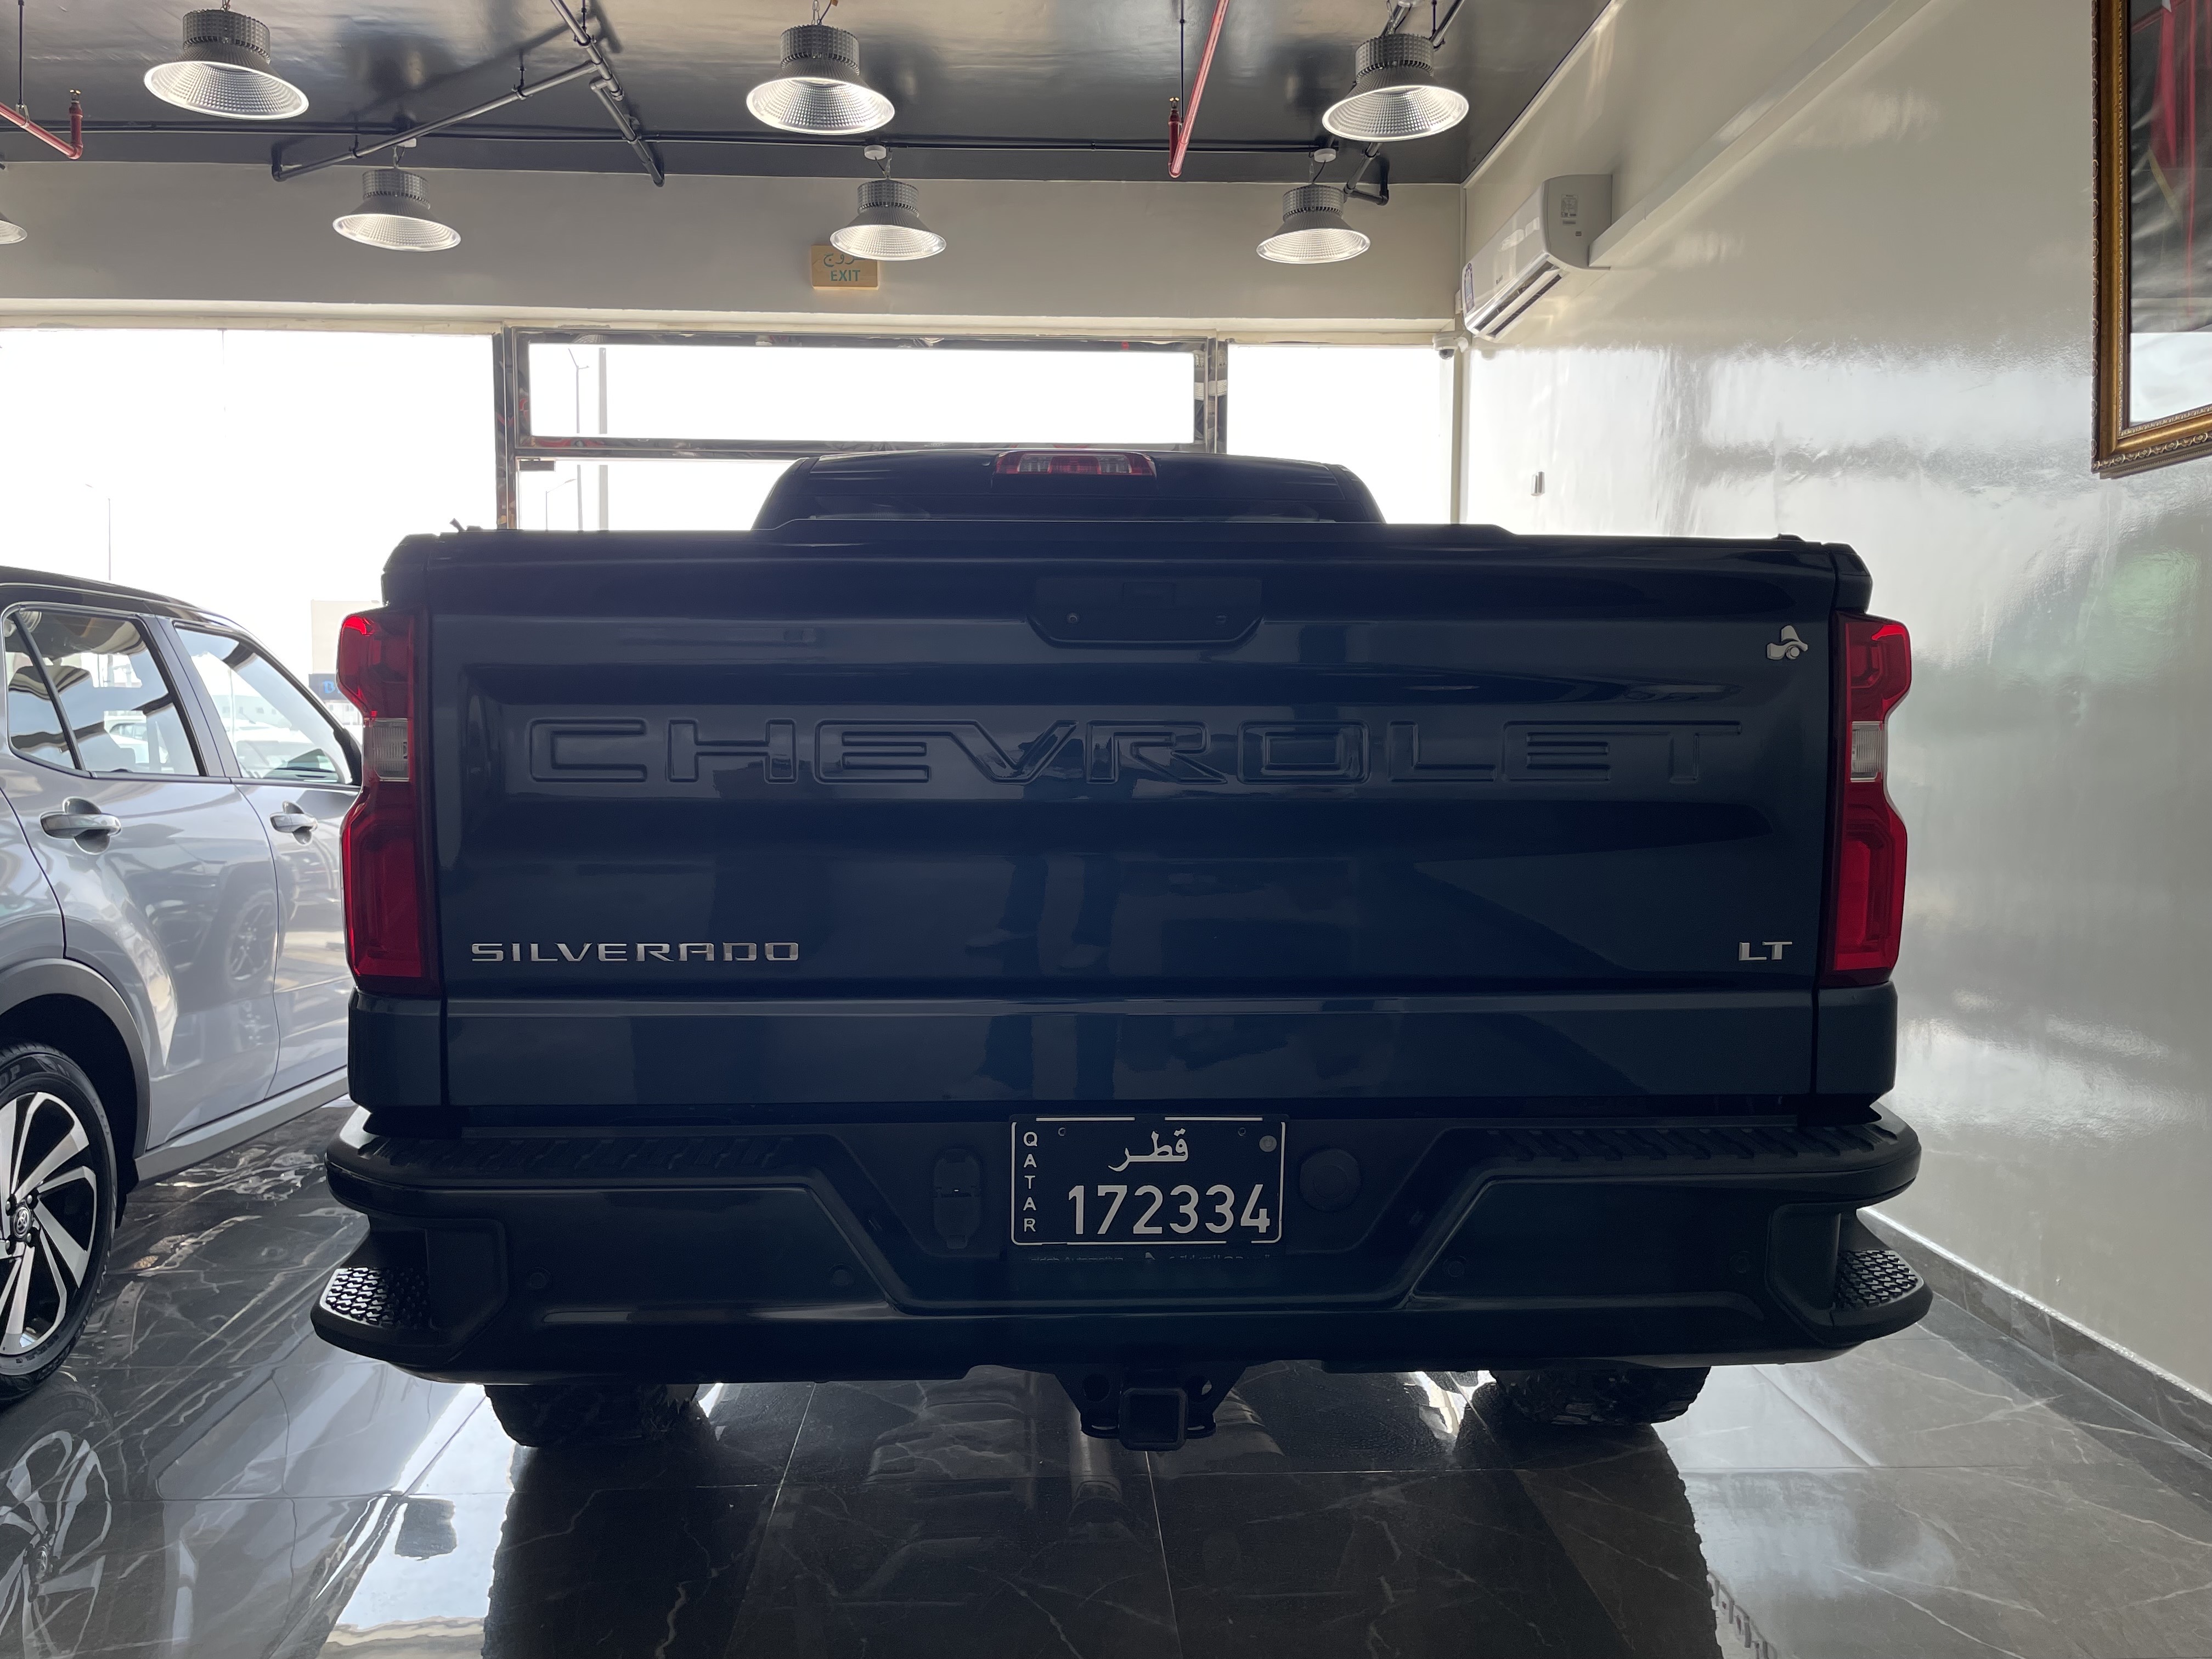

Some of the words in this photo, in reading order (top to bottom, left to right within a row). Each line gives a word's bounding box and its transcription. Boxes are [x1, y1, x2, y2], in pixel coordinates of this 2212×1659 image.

[823, 253, 865, 267] روج
[830, 269, 861, 281] EXIT
[528, 717, 1742, 785] CHEVROLET
[471, 942, 799, 962] SILVERADO
[1739, 941, 1793, 961] LT
[1108, 1128, 1188, 1172] قطر
[1023, 1131, 1038, 1233] QATAR
[1068, 1184, 1271, 1235] 172334
